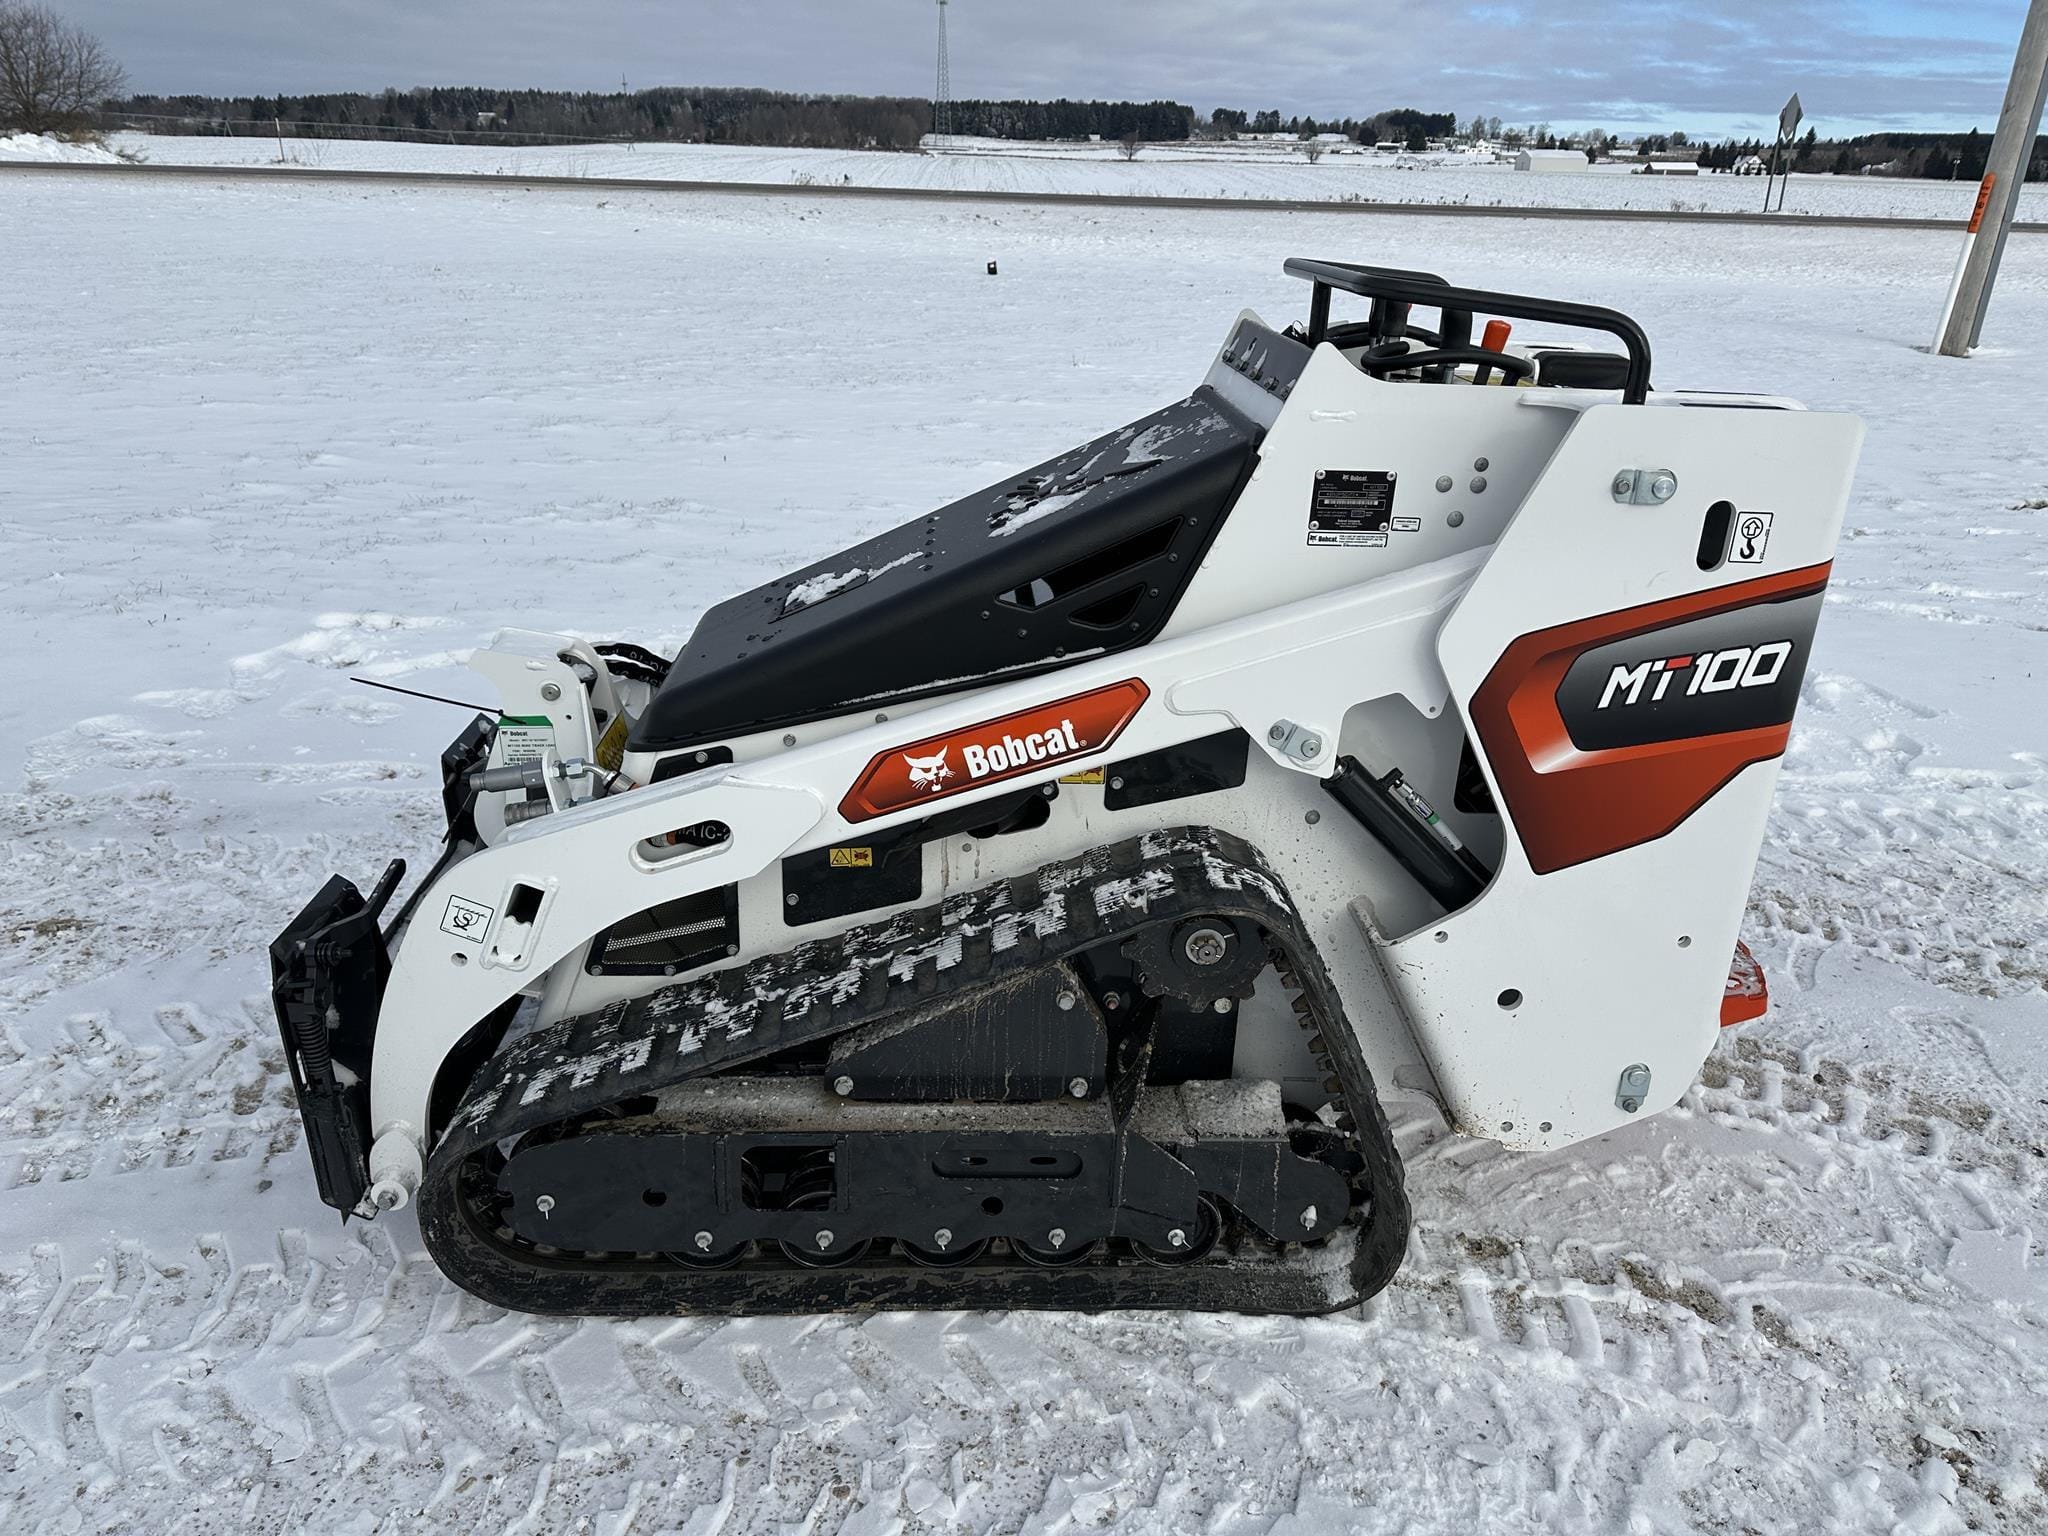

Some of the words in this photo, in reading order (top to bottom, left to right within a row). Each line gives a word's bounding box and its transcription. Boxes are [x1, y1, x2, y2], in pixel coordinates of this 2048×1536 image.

[1318, 535, 1338, 543] Bobcat
[1597, 641, 1792, 709] MT100
[963, 719, 1079, 779] Bobcat
